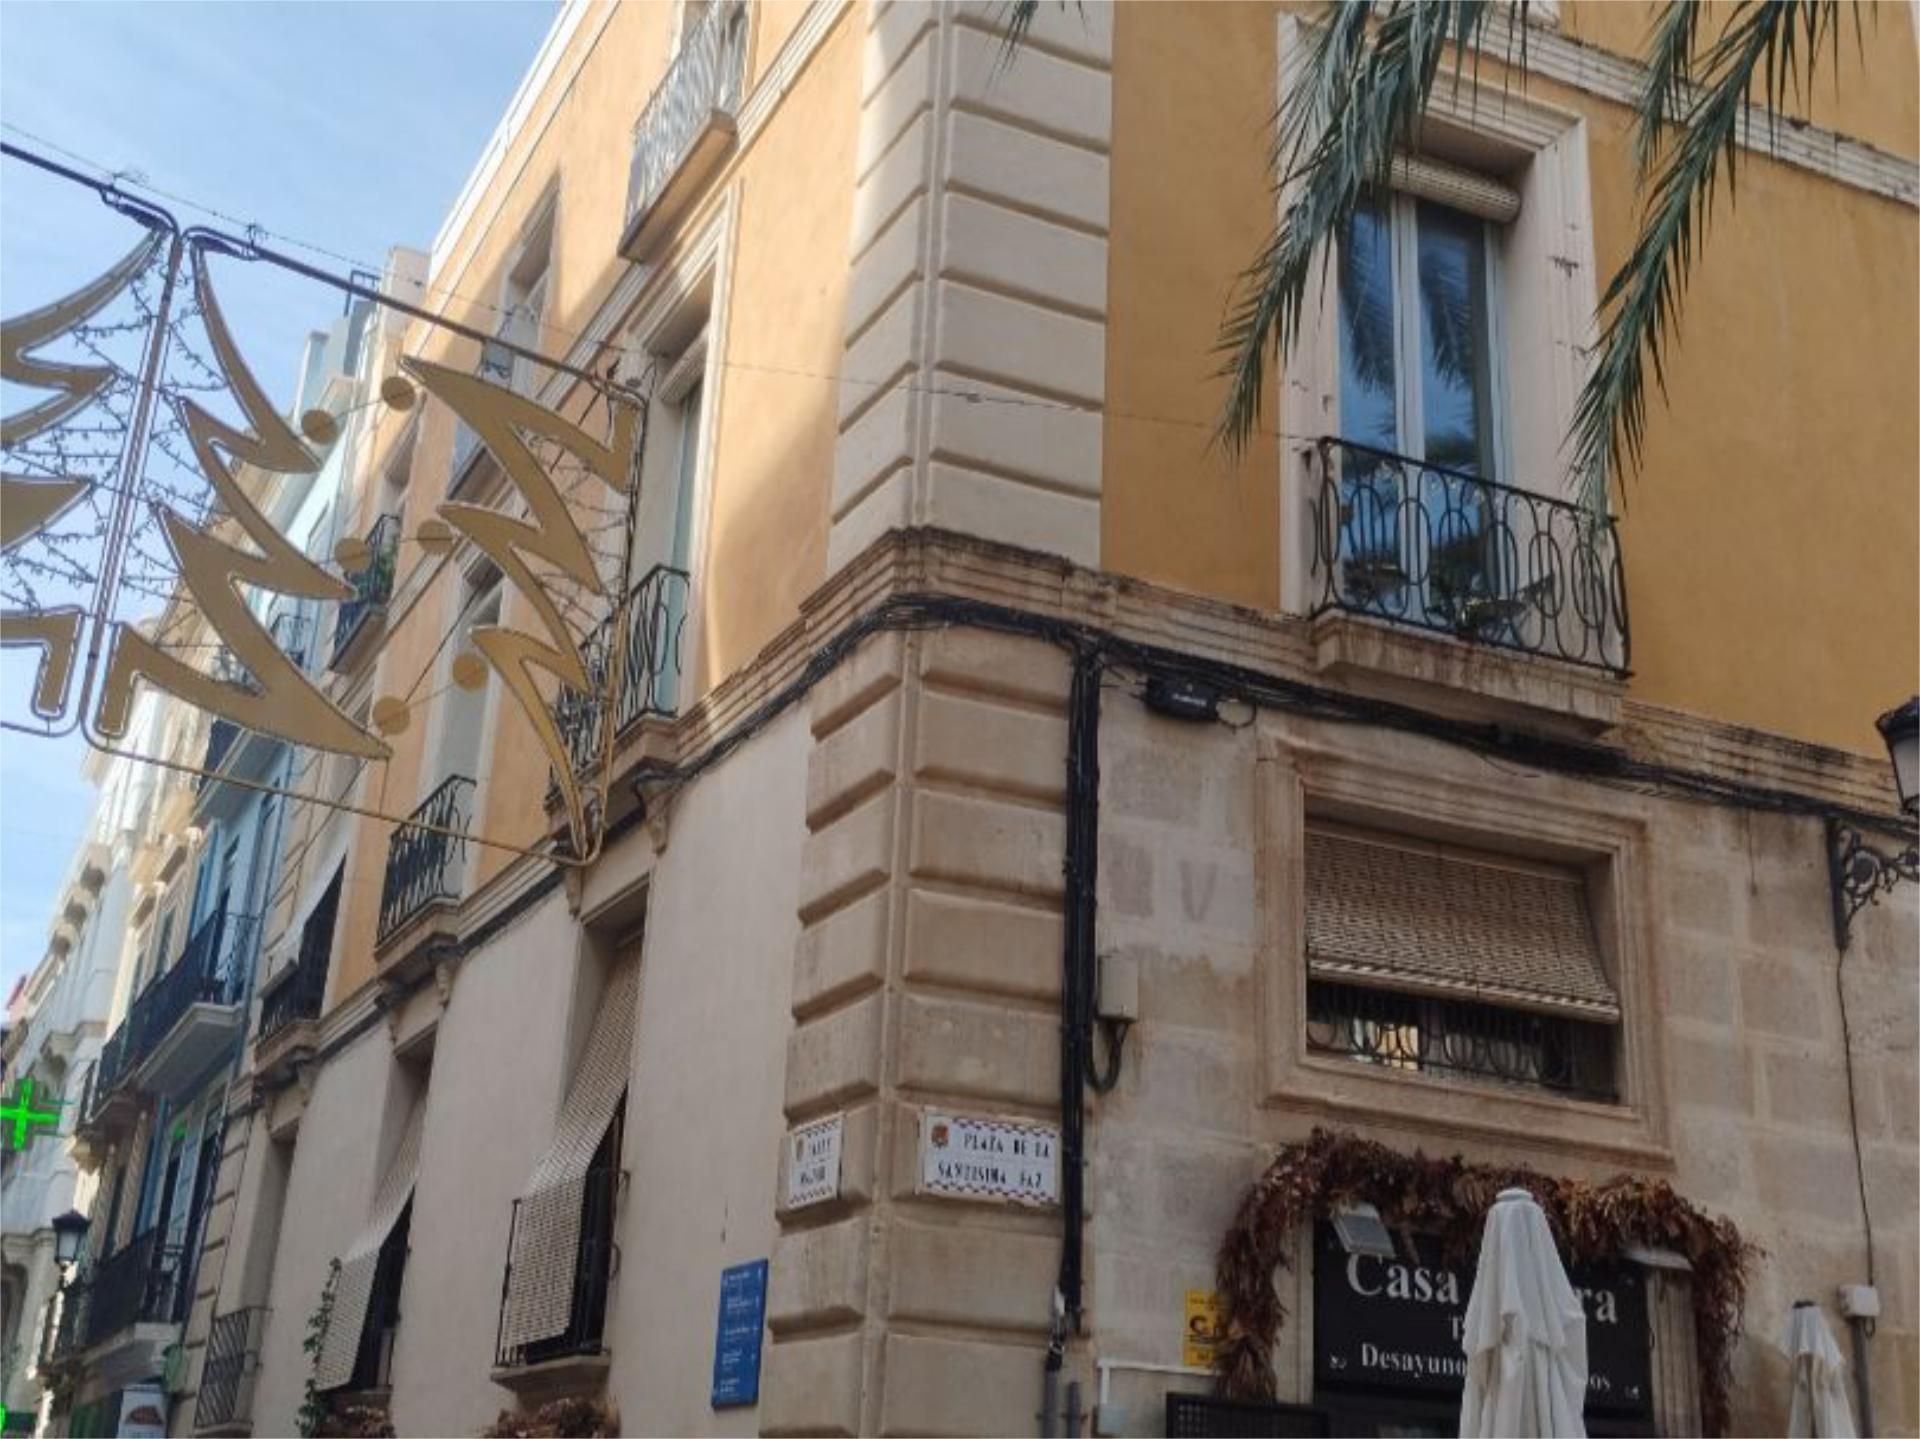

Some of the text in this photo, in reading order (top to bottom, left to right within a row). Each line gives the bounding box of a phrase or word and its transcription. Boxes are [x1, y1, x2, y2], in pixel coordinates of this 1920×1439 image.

[963, 1132, 1003, 1153] PLAZA
[1013, 1139, 1026, 1156] DE
[1346, 1252, 1459, 1304] Casa
[1361, 1342, 1467, 1378] Desayuno
